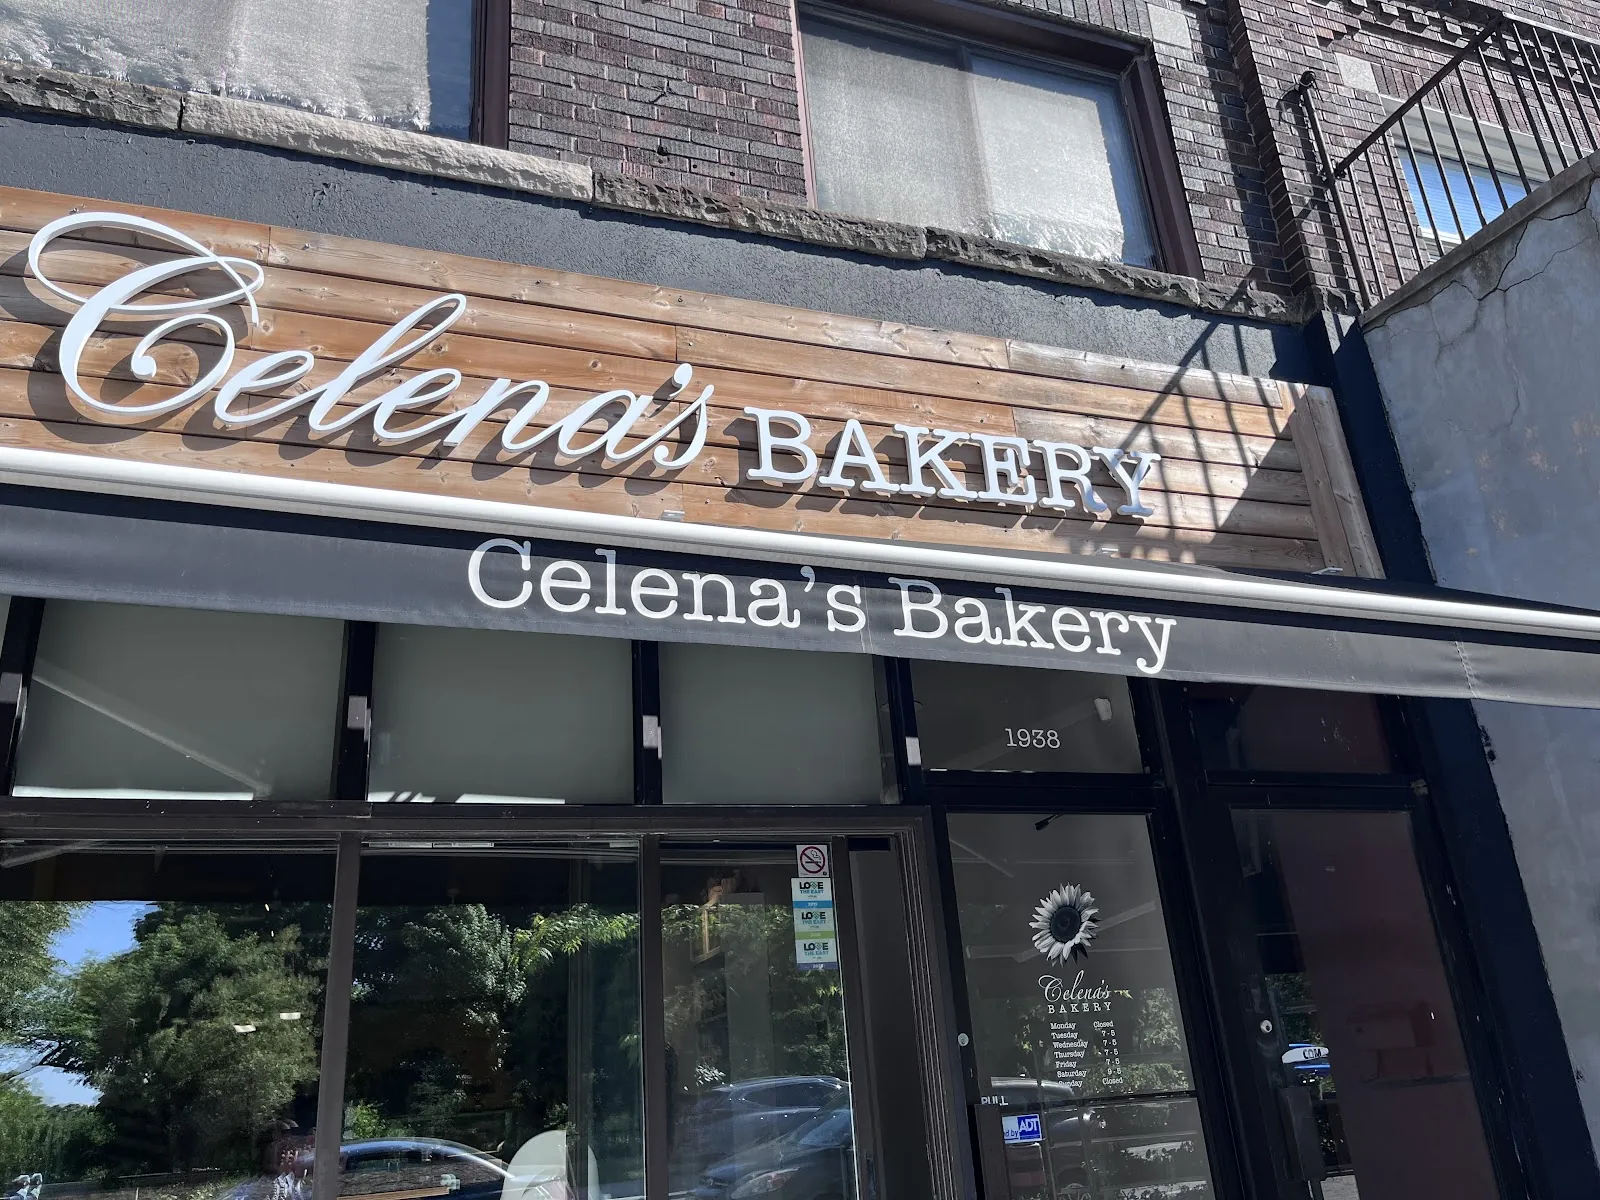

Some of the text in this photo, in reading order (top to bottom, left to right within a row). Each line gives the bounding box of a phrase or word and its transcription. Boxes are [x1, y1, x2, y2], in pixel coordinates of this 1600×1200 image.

[27, 210, 1161, 517] Celena's BAKERY
[467, 538, 1177, 675] Celena's Bakery
[1005, 728, 1060, 749] 1938
[1038, 970, 1112, 1002] Celena's
[1048, 1001, 1112, 1014] BAKERY
[1050, 1020, 1114, 1030] Monday Closed
[1051, 1031, 1078, 1039] Tuesday
[1053, 1040, 1089, 1049] Wednesday
[1053, 1049, 1085, 1059] Thursday
[1055, 1060, 1077, 1069] Friday
[1056, 1069, 1087, 1078] Saturday
[1102, 1077, 1123, 1085] Closed
[1011, 1129, 1019, 1138] by
[1019, 1118, 1039, 1132] ADT
